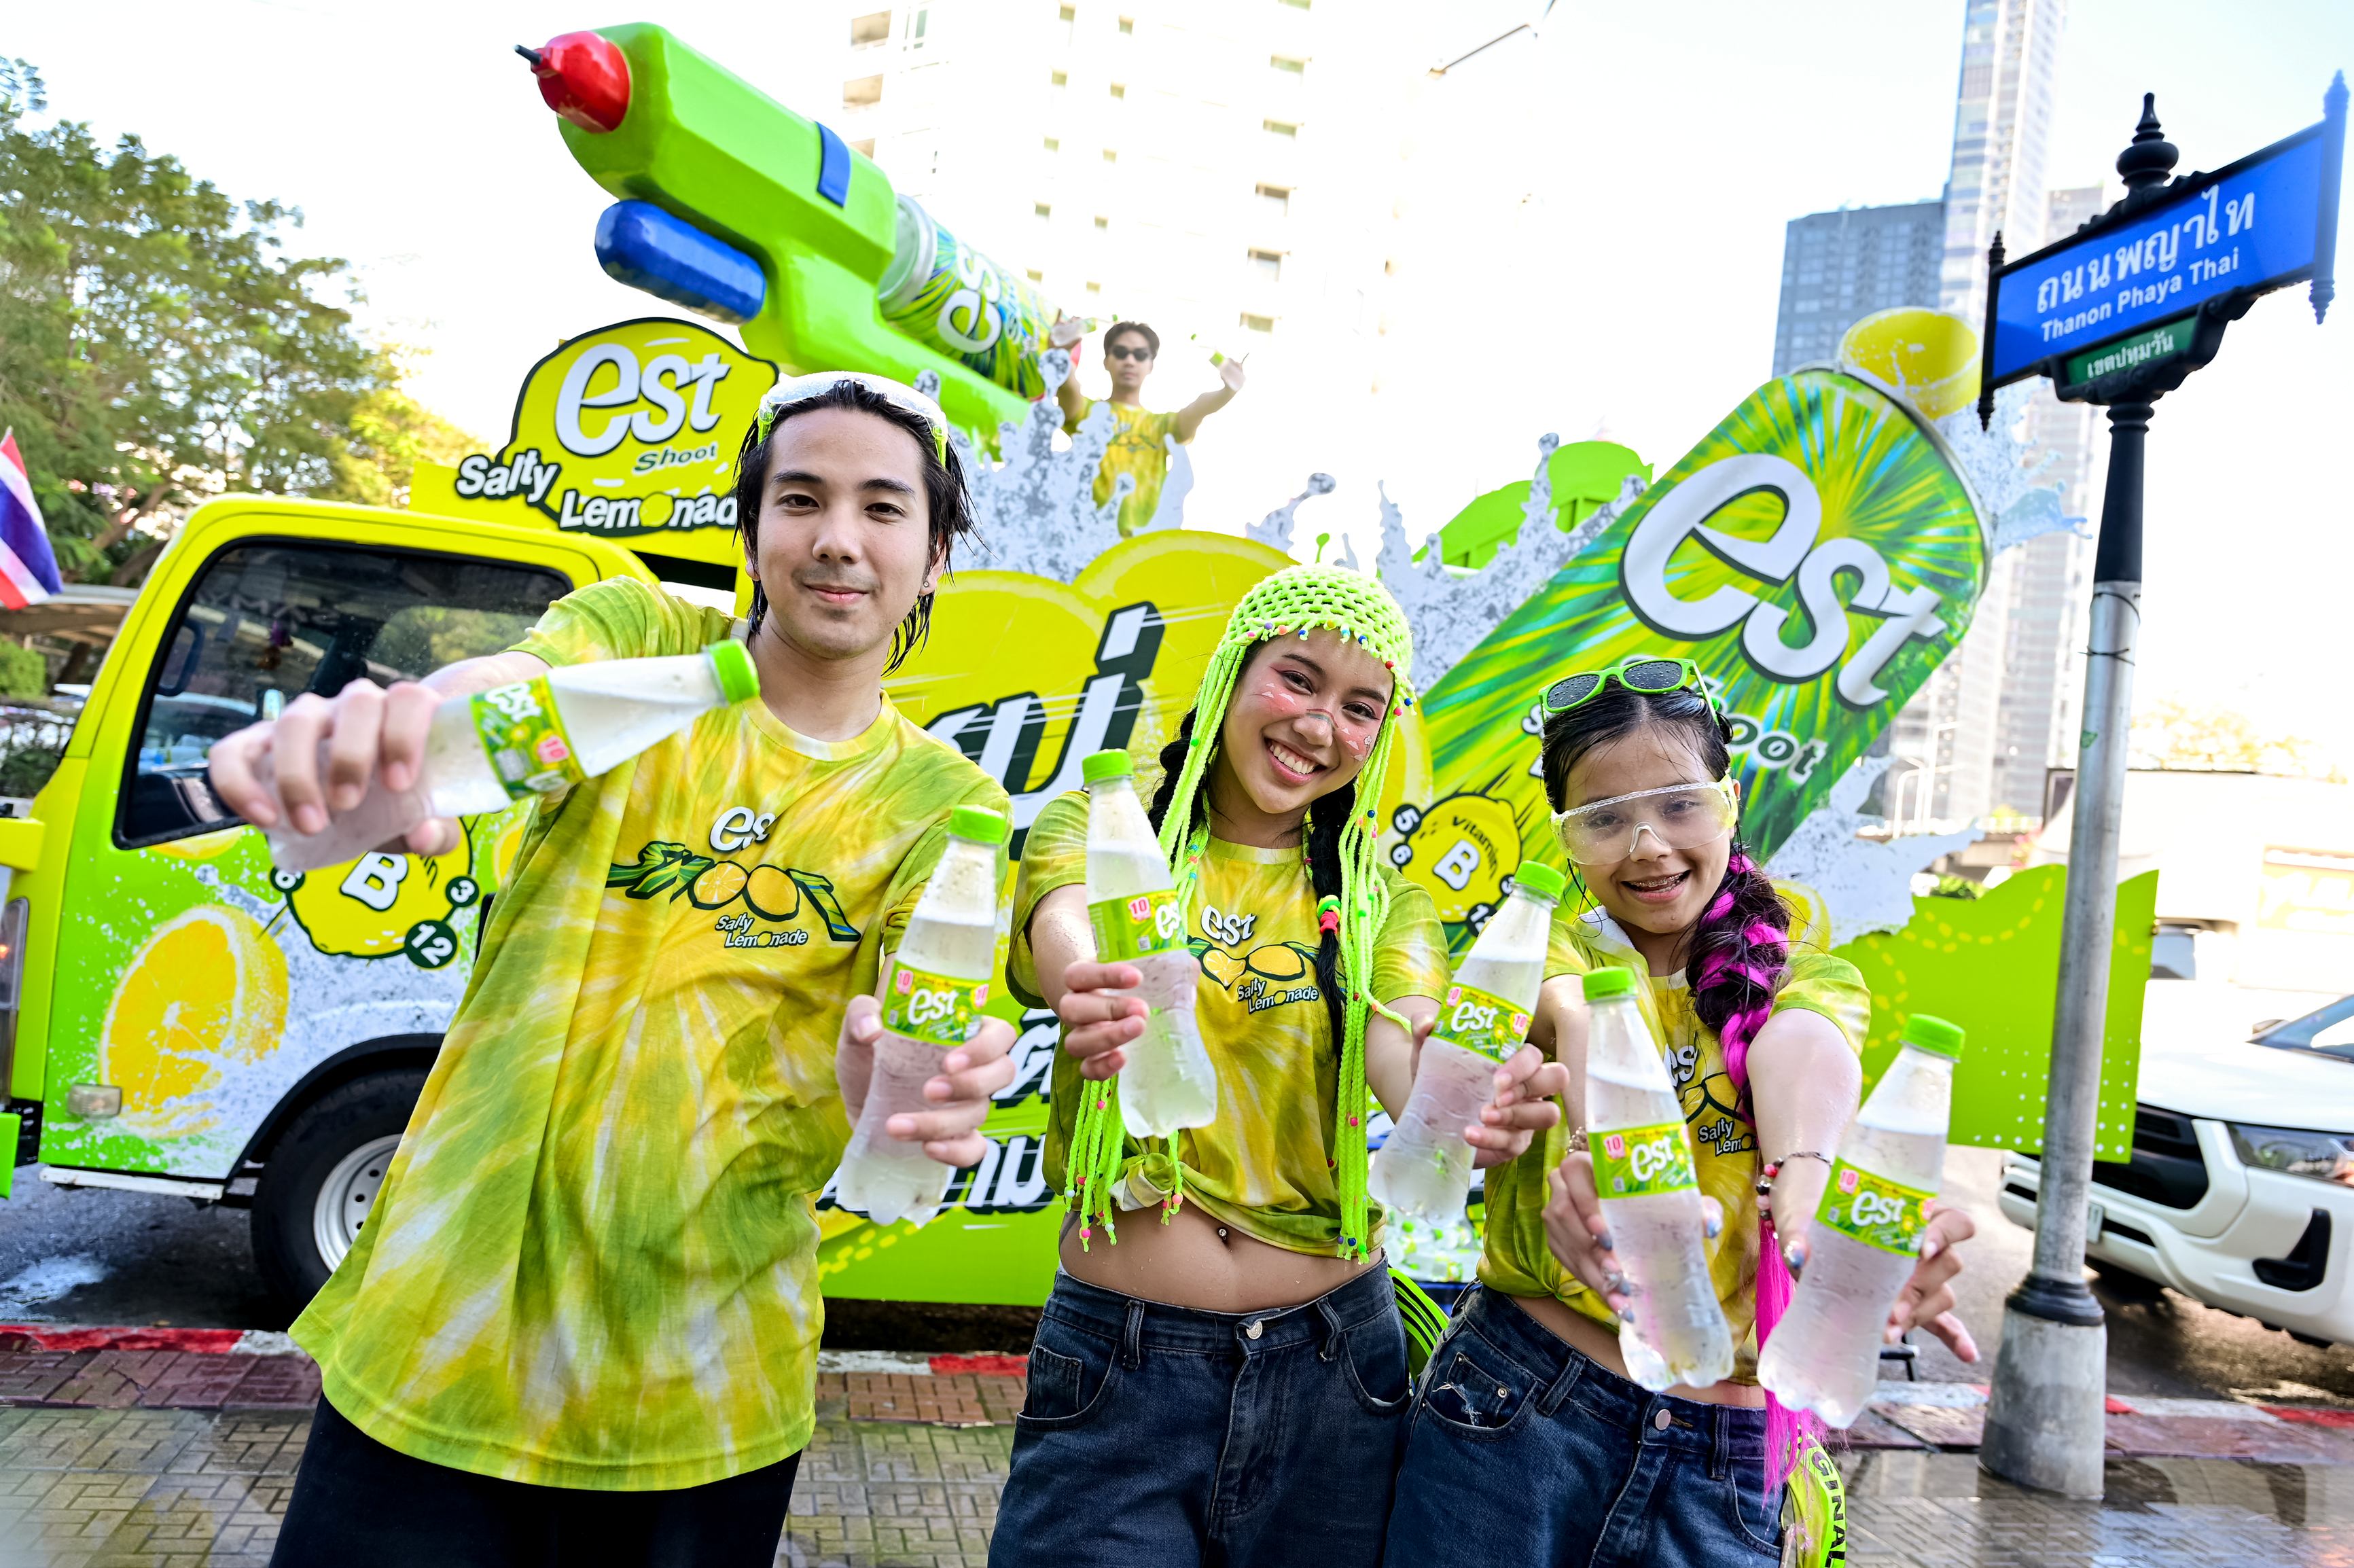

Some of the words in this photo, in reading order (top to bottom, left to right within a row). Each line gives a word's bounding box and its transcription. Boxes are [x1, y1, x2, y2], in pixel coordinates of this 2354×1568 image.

[2037, 185, 2255, 313] ถนนพญาไท
[2041, 304, 2111, 342] Thanon
[2118, 272, 2181, 314] Phaya
[2189, 247, 2239, 285] Thai
[2087, 331, 2174, 378] เขตปทุมวัน
[556, 343, 730, 456] est
[456, 450, 560, 501] Salty
[632, 442, 717, 472] Shoot
[560, 491, 737, 529] Lemonad
[1620, 452, 1947, 711] est
[709, 806, 777, 852] es
[1395, 808, 1420, 832] 5
[1392, 844, 1412, 864] 6
[1433, 839, 1480, 891] B
[340, 851, 408, 911] B
[450, 880, 475, 903] 3
[715, 912, 754, 931] Salty
[725, 929, 808, 948] Lemonade
[1201, 905, 1257, 947] est
[411, 923, 453, 966] 12
[908, 988, 959, 1024] est
[1238, 978, 1266, 1001] Salty
[1248, 986, 1319, 1014] Lemonade
[1451, 1001, 1499, 1032] est
[1698, 1118, 1734, 1142] Salty
[1631, 1136, 1675, 1181] est
[1851, 1190, 1907, 1226] est
